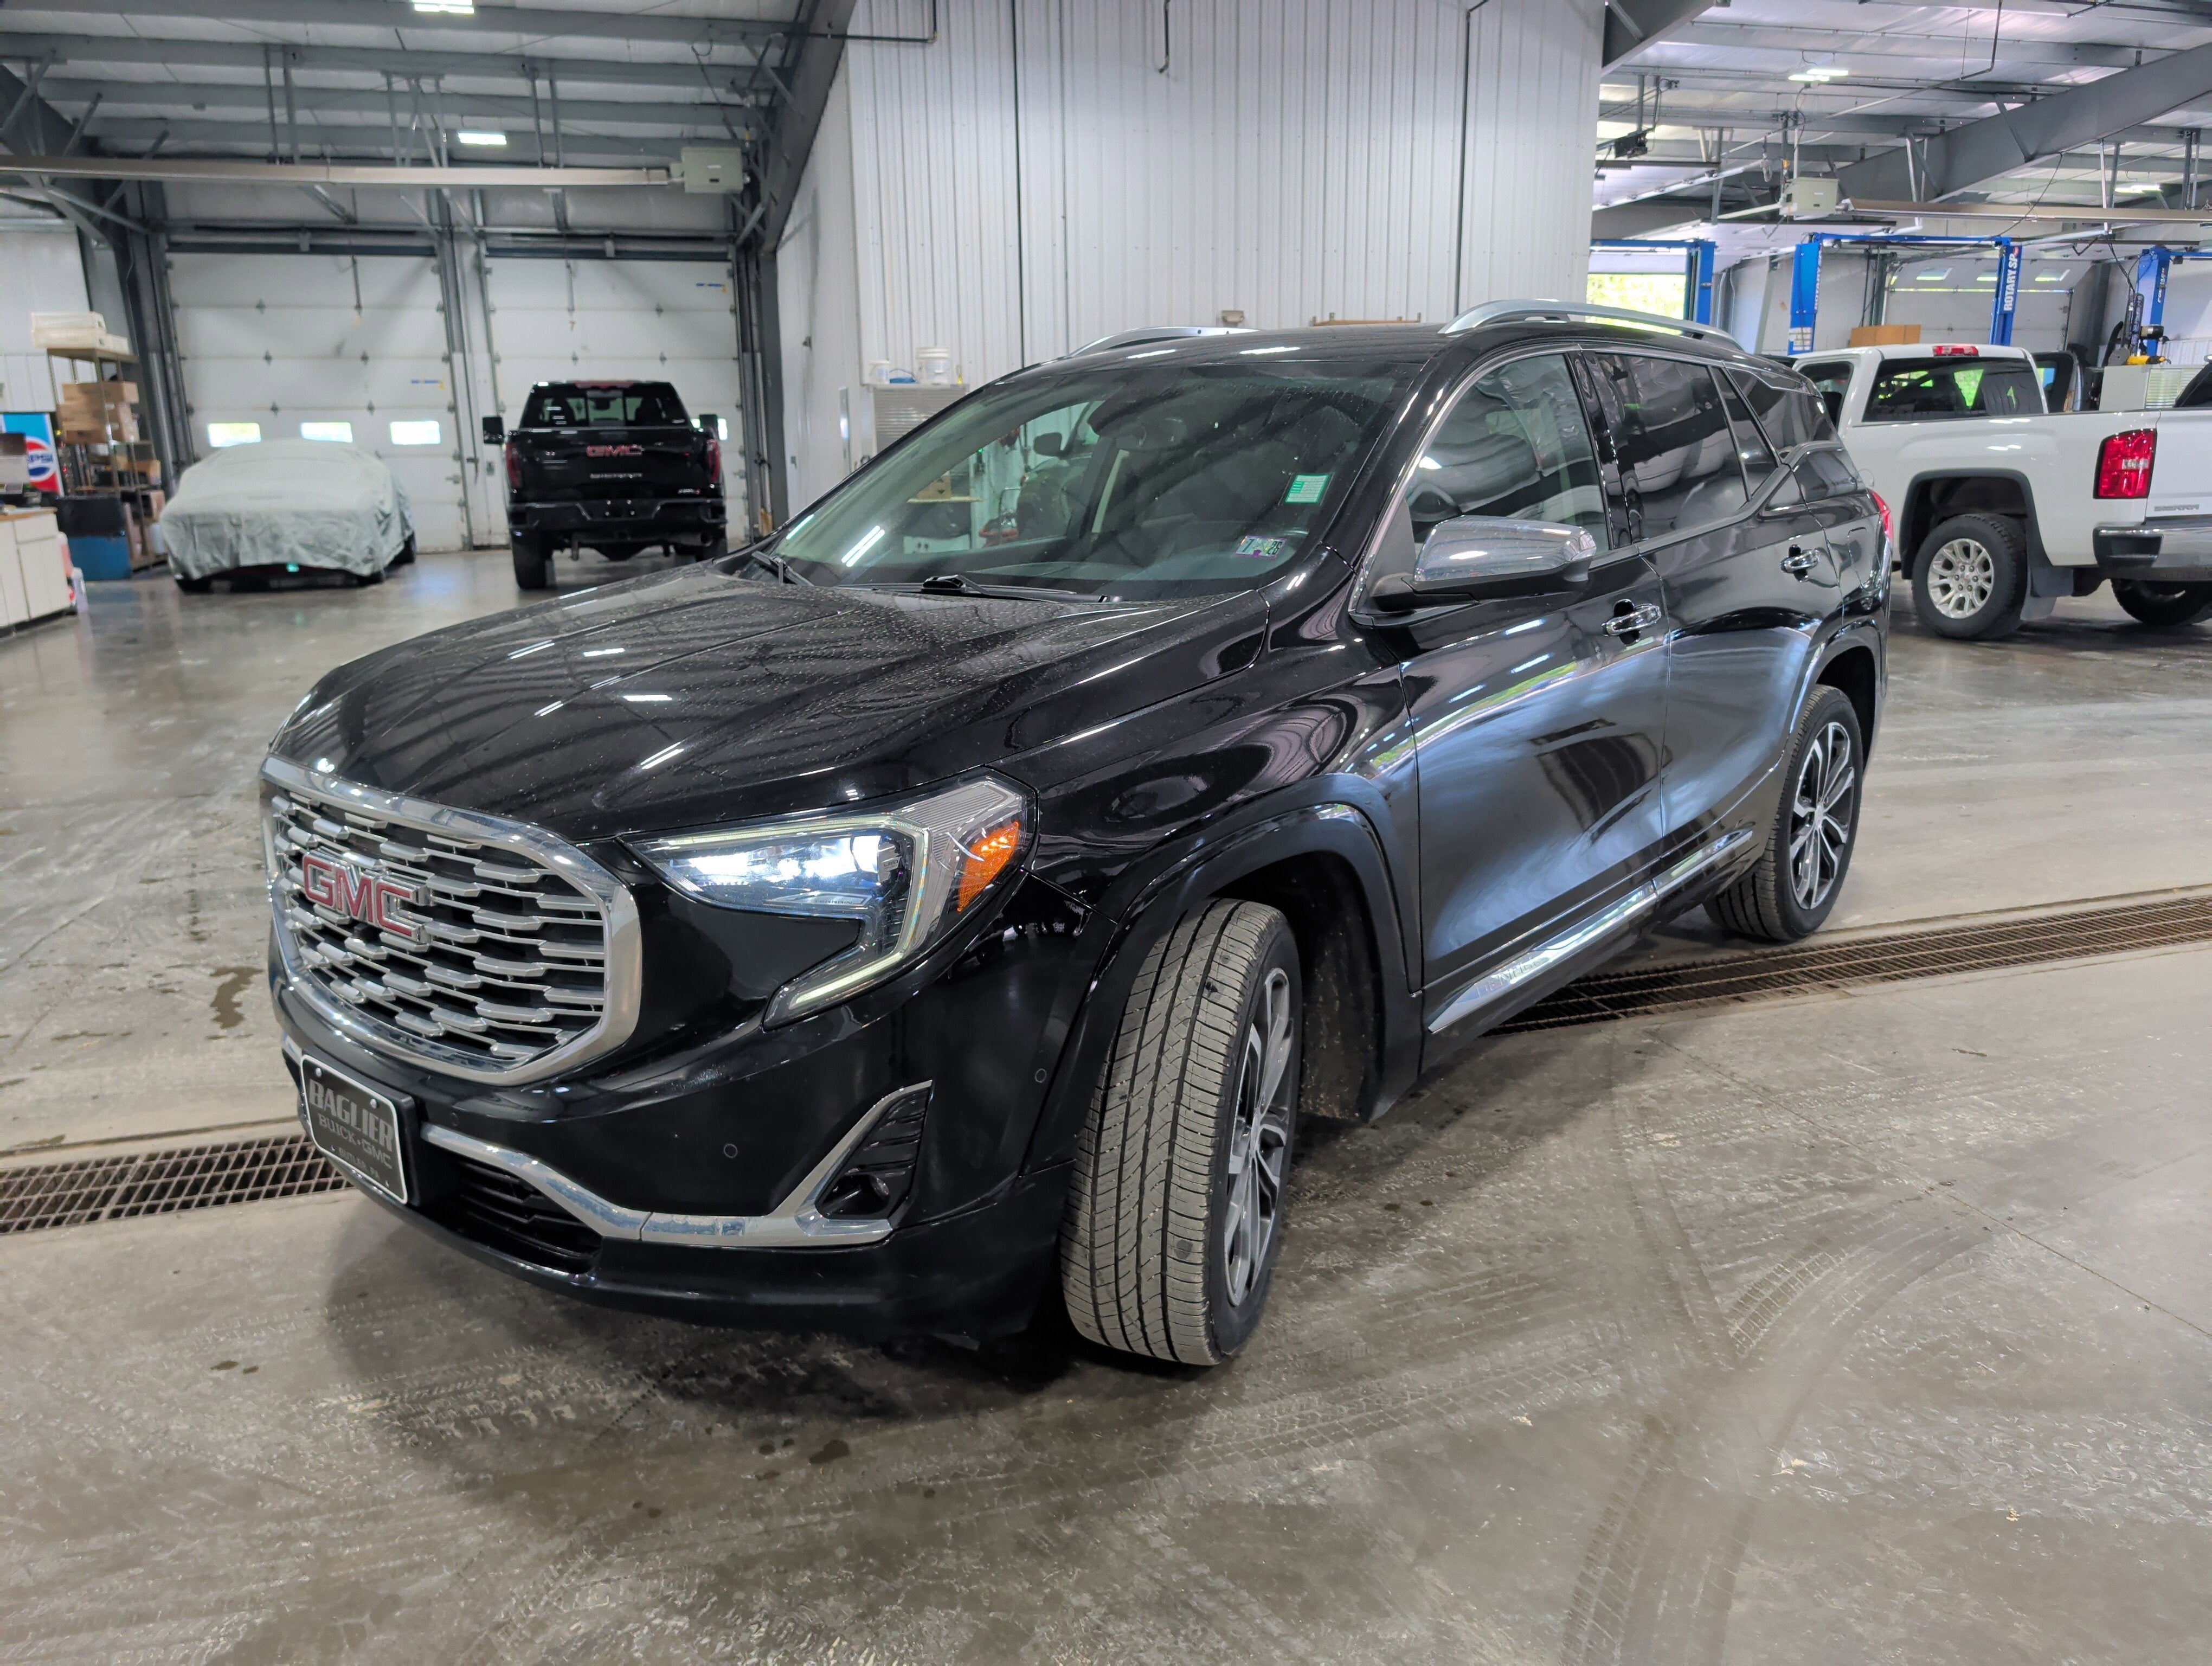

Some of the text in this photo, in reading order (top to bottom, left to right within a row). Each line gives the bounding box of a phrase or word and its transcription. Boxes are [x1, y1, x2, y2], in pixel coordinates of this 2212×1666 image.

[2008, 253, 2018, 268] SP
[2003, 269, 2016, 311] ROTARY
[587, 445, 644, 457] GMC
[303, 854, 419, 940] GMC
[309, 1079, 393, 1152] BAGLIER
[318, 1113, 391, 1169] BUICK GMC
